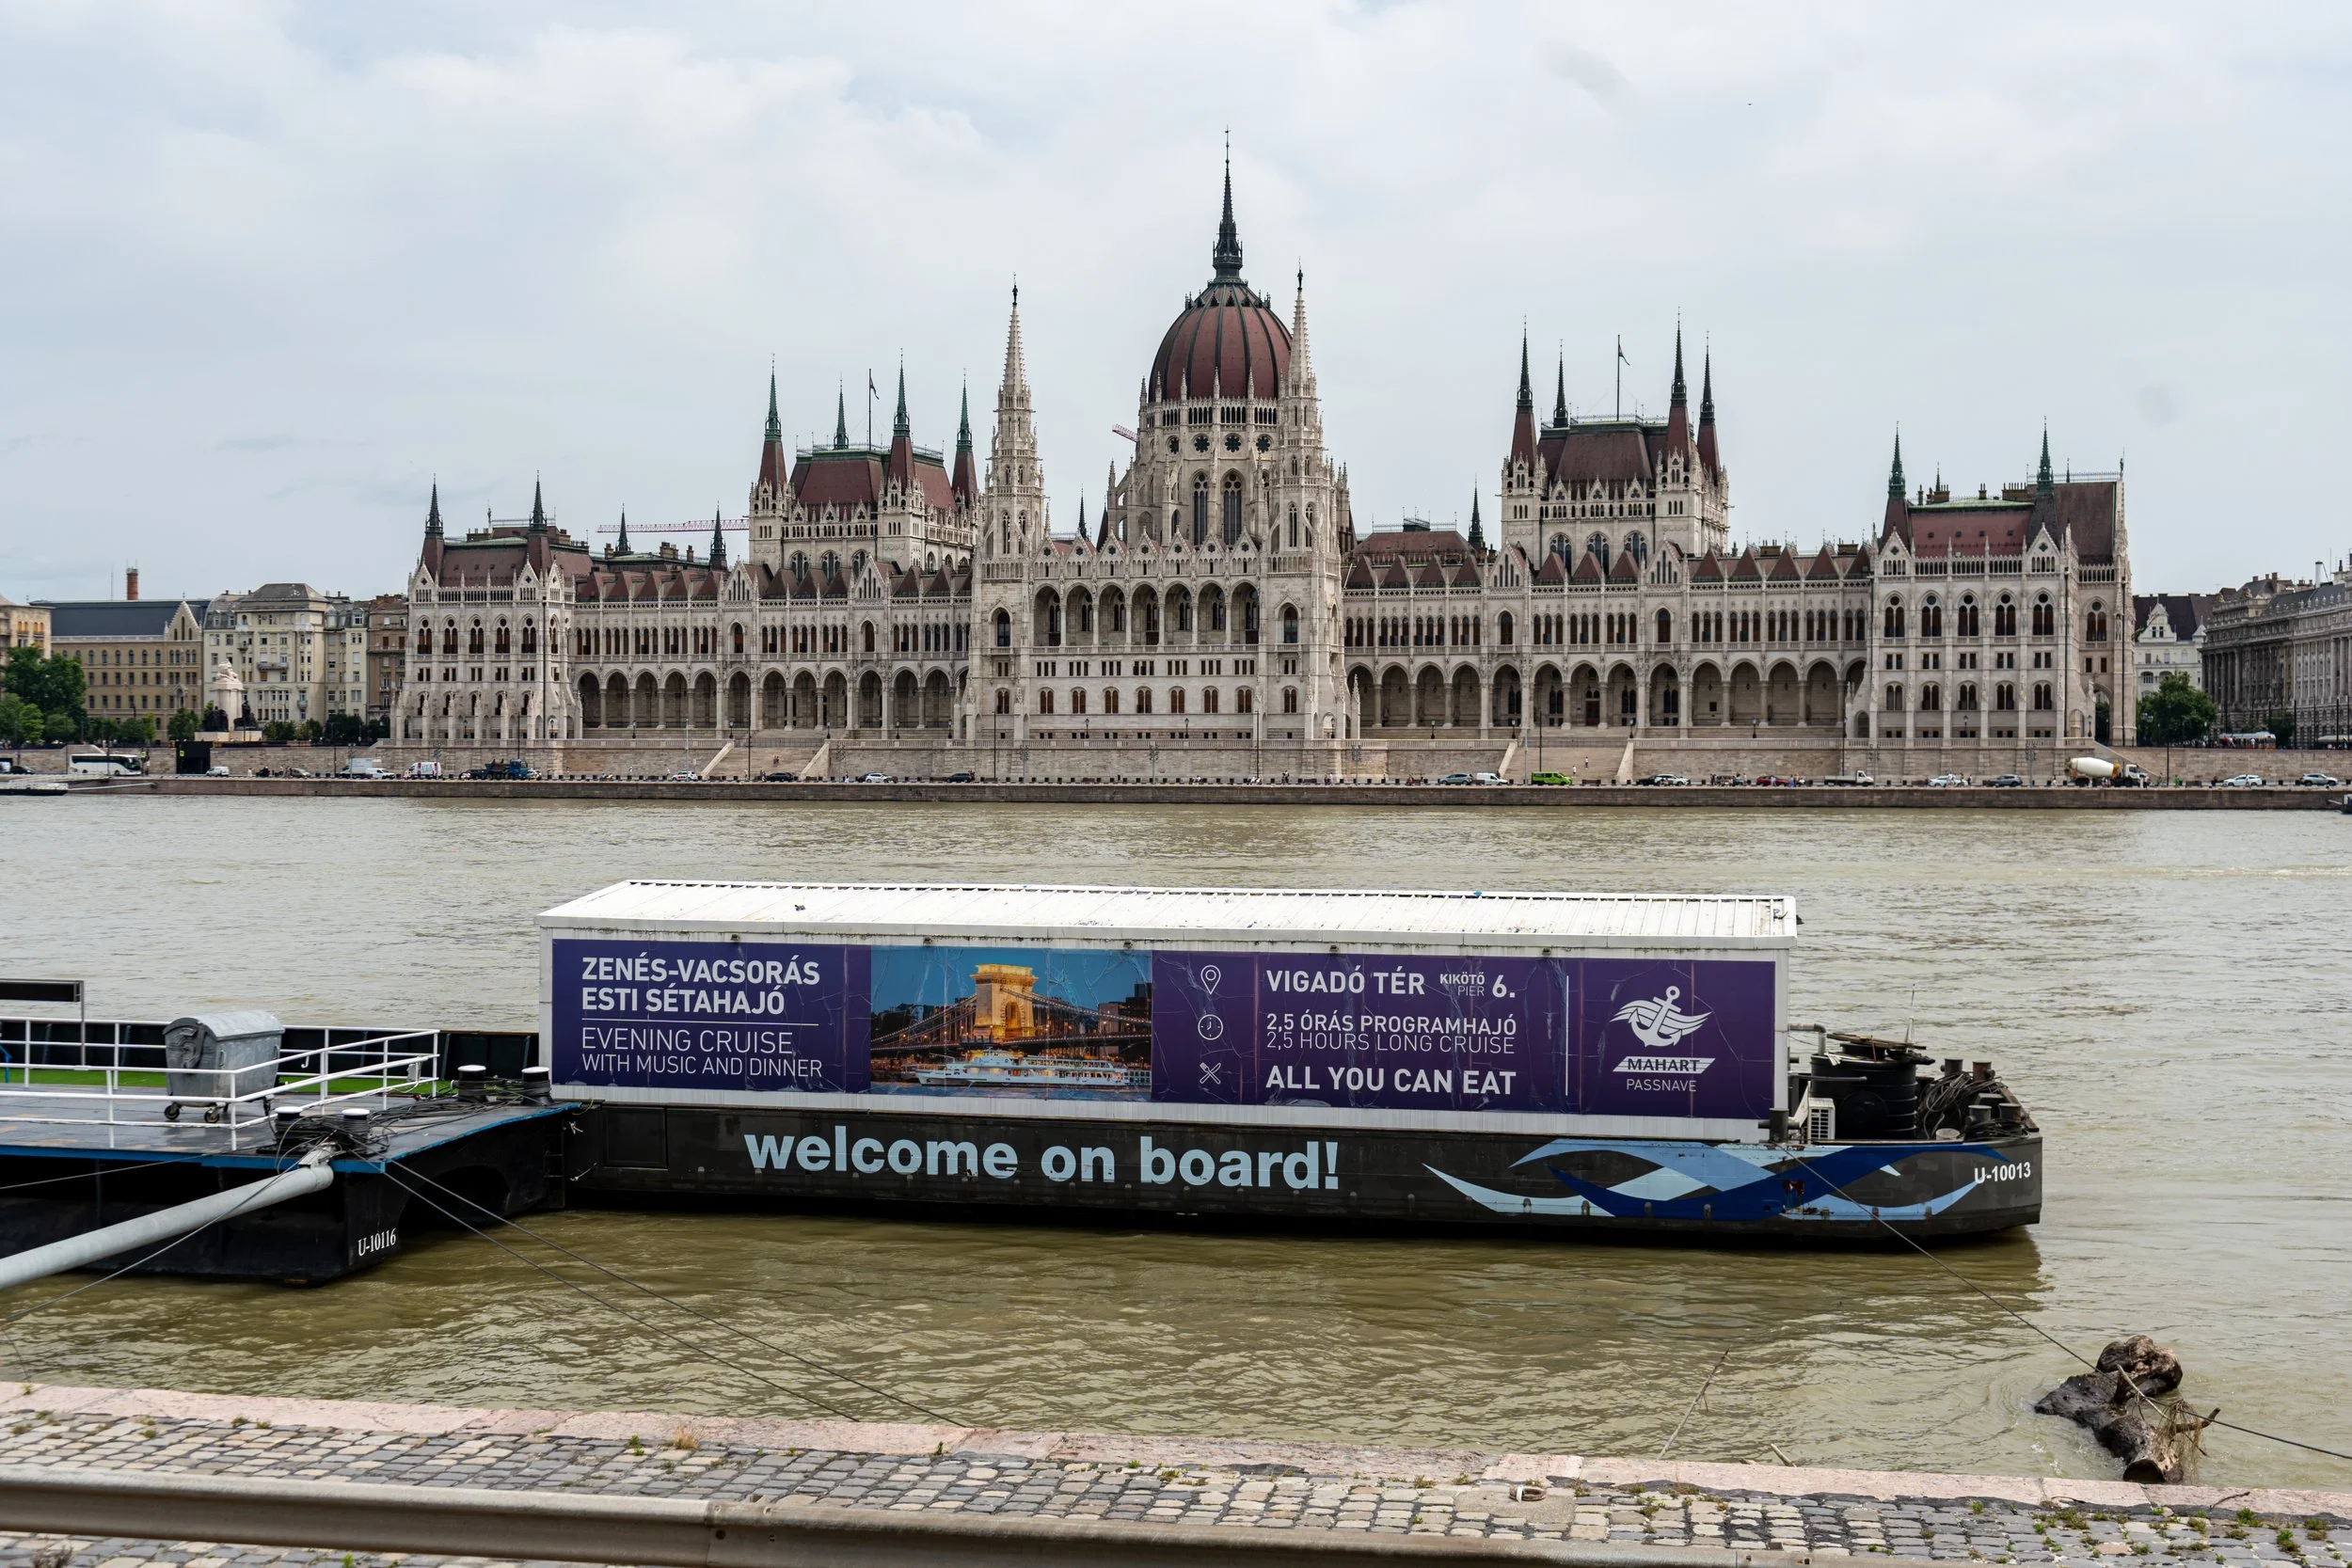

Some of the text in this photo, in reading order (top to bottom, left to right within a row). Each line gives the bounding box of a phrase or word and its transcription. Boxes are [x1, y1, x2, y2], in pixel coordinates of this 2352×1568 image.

[582, 952, 820, 985] ZENÉS-VACSORÁS
[1266, 965, 1425, 995] VIGADÓ TÉR
[1439, 972, 1486, 985] KIKÖTŐ
[582, 983, 785, 1015] ESTI SÉTAHAJÓ
[1457, 985, 1485, 997] PIER
[1492, 974, 1516, 998] 6.
[1266, 1009, 1517, 1036] 2,5 ÓRÁS PROGRAMHAJÓ
[581, 1027, 793, 1054] EVENING CRUISE
[1266, 1032, 1515, 1054] 2,5 HOURS LONG CRUISE
[581, 1053, 822, 1078] WITH MUSIC AND DINNER
[1628, 1058, 1700, 1072] MAHART
[1265, 1065, 1517, 1095] ALL YOU CAN EAT
[1627, 1078, 1697, 1092] PASSNAVE
[744, 1126, 1339, 1191] welcome on board!
[1974, 1161, 2031, 1184] U-10013
[358, 1227, 397, 1257] U-10116
